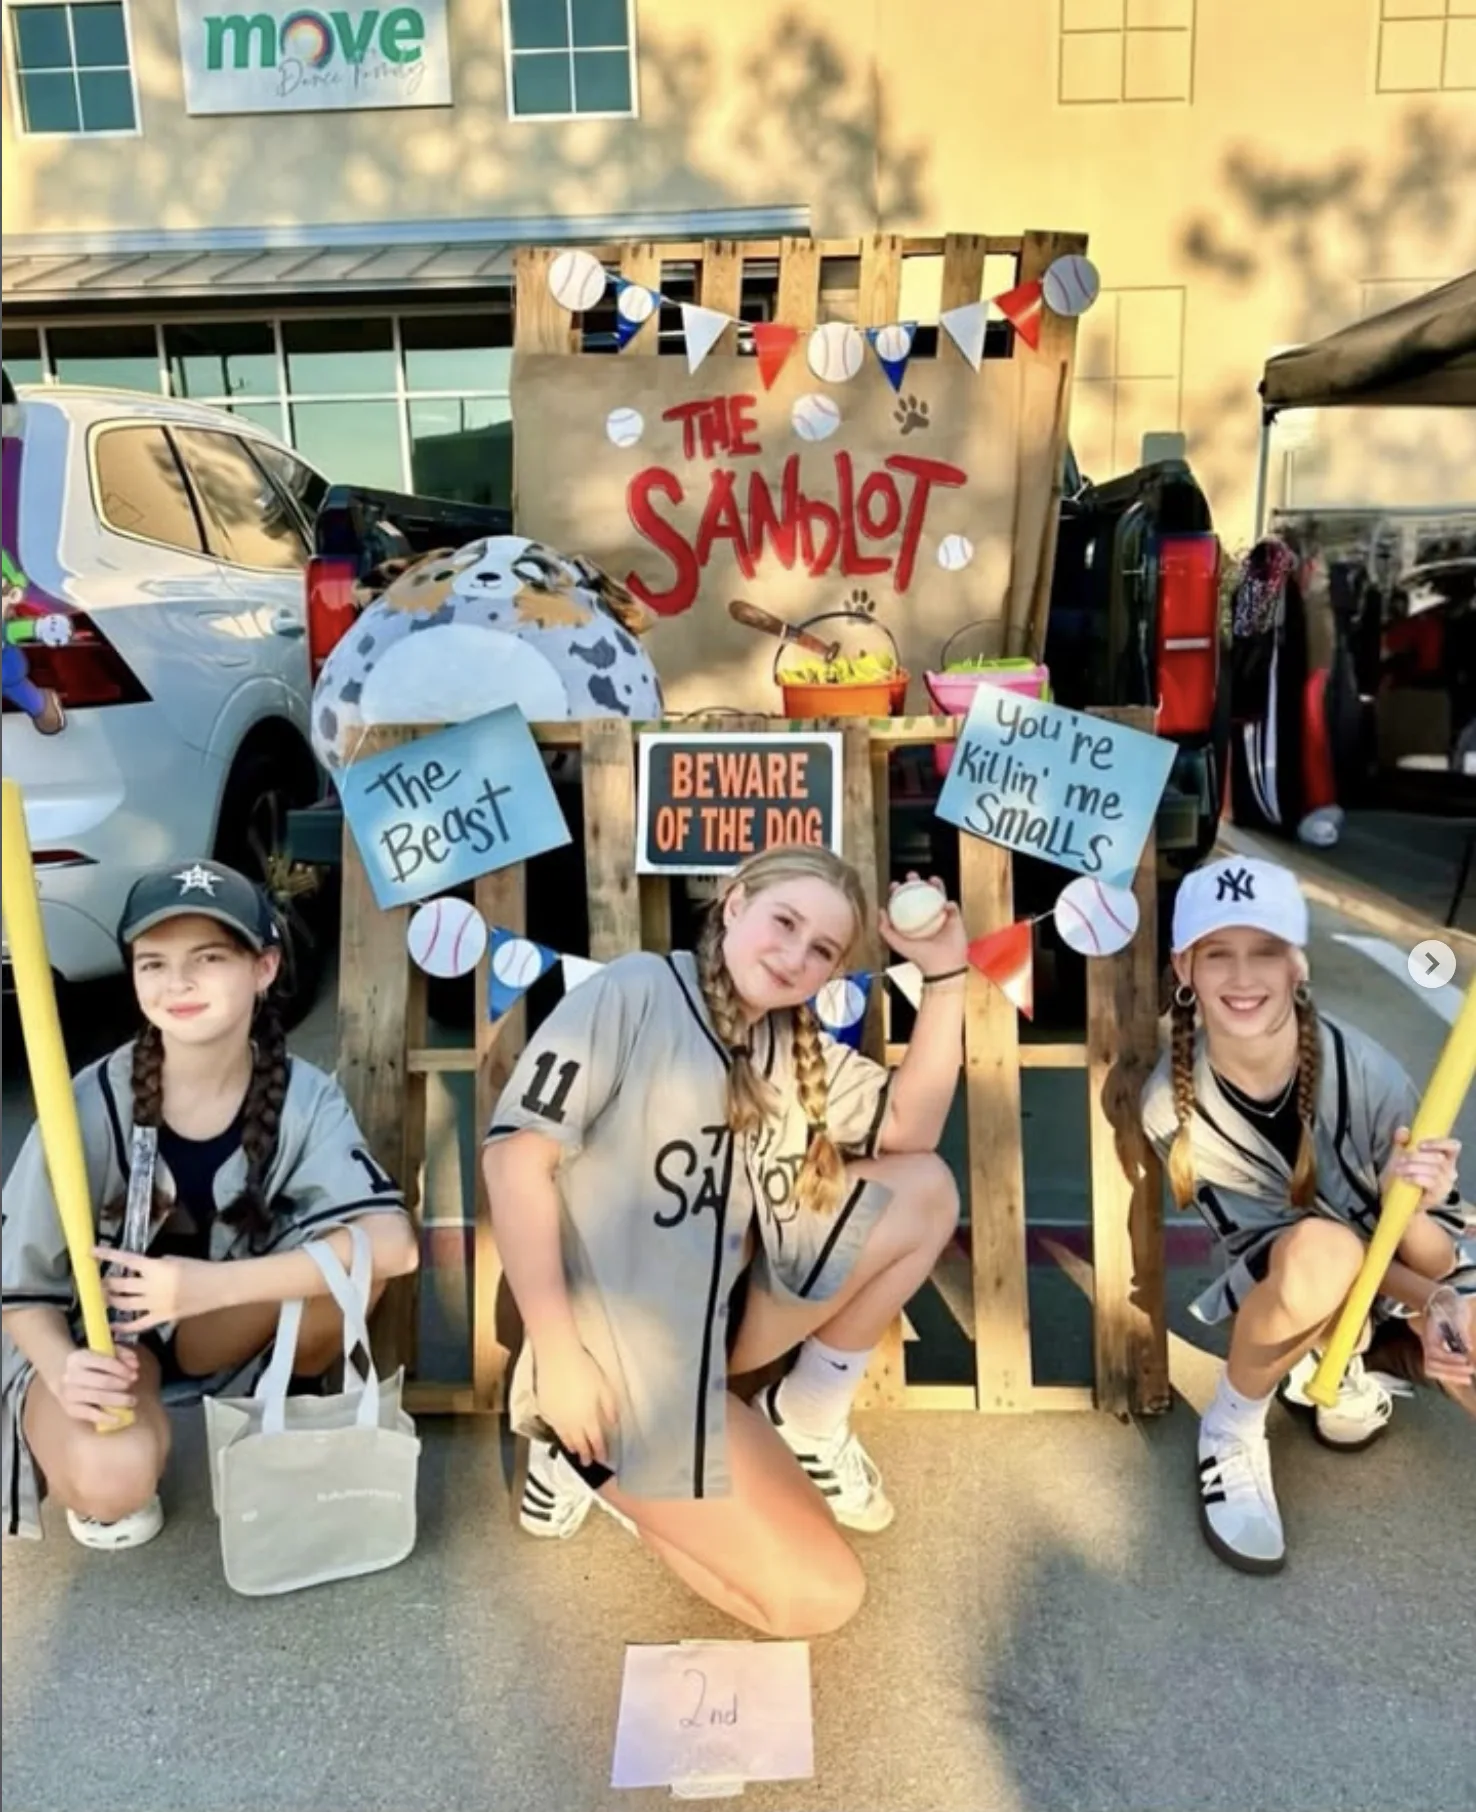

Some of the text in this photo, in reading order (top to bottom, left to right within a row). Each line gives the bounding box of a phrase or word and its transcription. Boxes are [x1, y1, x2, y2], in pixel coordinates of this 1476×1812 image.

[203, 8, 425, 70] move
[662, 394, 762, 460] THE
[625, 451, 967, 617] SANDLOT
[996, 698, 1114, 770] You're
[364, 760, 462, 809] The
[672, 752, 809, 799] BEWARE
[1064, 782, 1124, 820] me
[379, 777, 512, 882] Beast
[656, 806, 823, 852] OF THE DOG
[1216, 868, 1255, 902] NY
[521, 1051, 580, 1123] 11
[679, 1668, 738, 1728] 2nd
